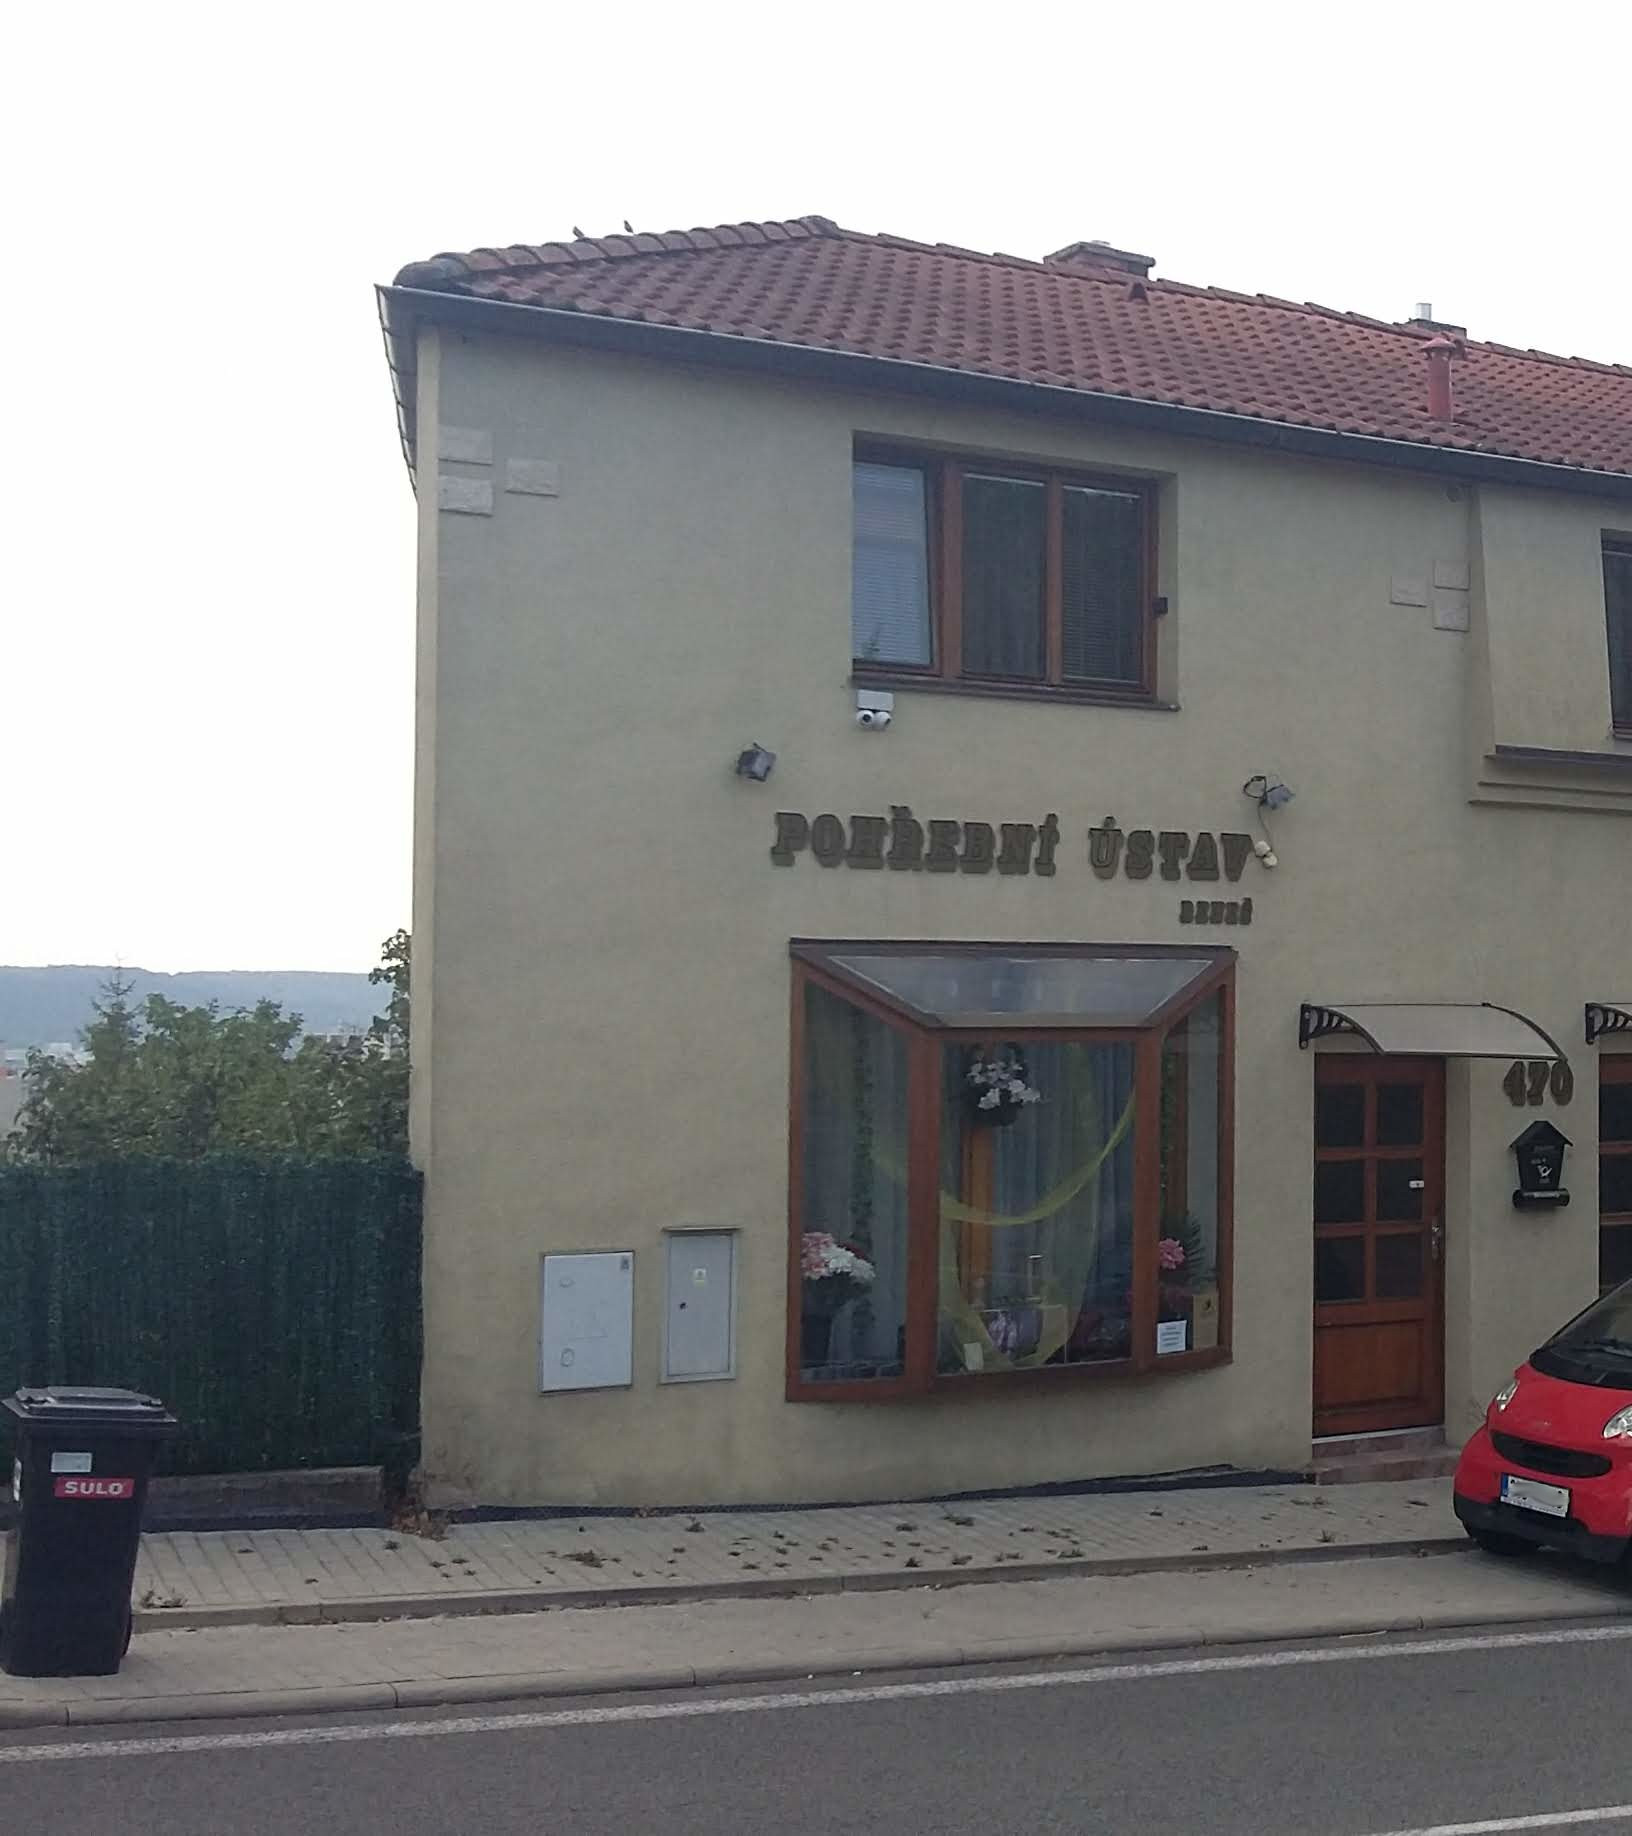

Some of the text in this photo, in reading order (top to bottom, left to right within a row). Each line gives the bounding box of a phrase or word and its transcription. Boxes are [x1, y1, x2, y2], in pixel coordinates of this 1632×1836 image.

[770, 804, 1253, 882] POHŘEBNÍ ÚSTAV
[1502, 1061, 1574, 1107] 470
[64, 1481, 124, 1495] SULO
